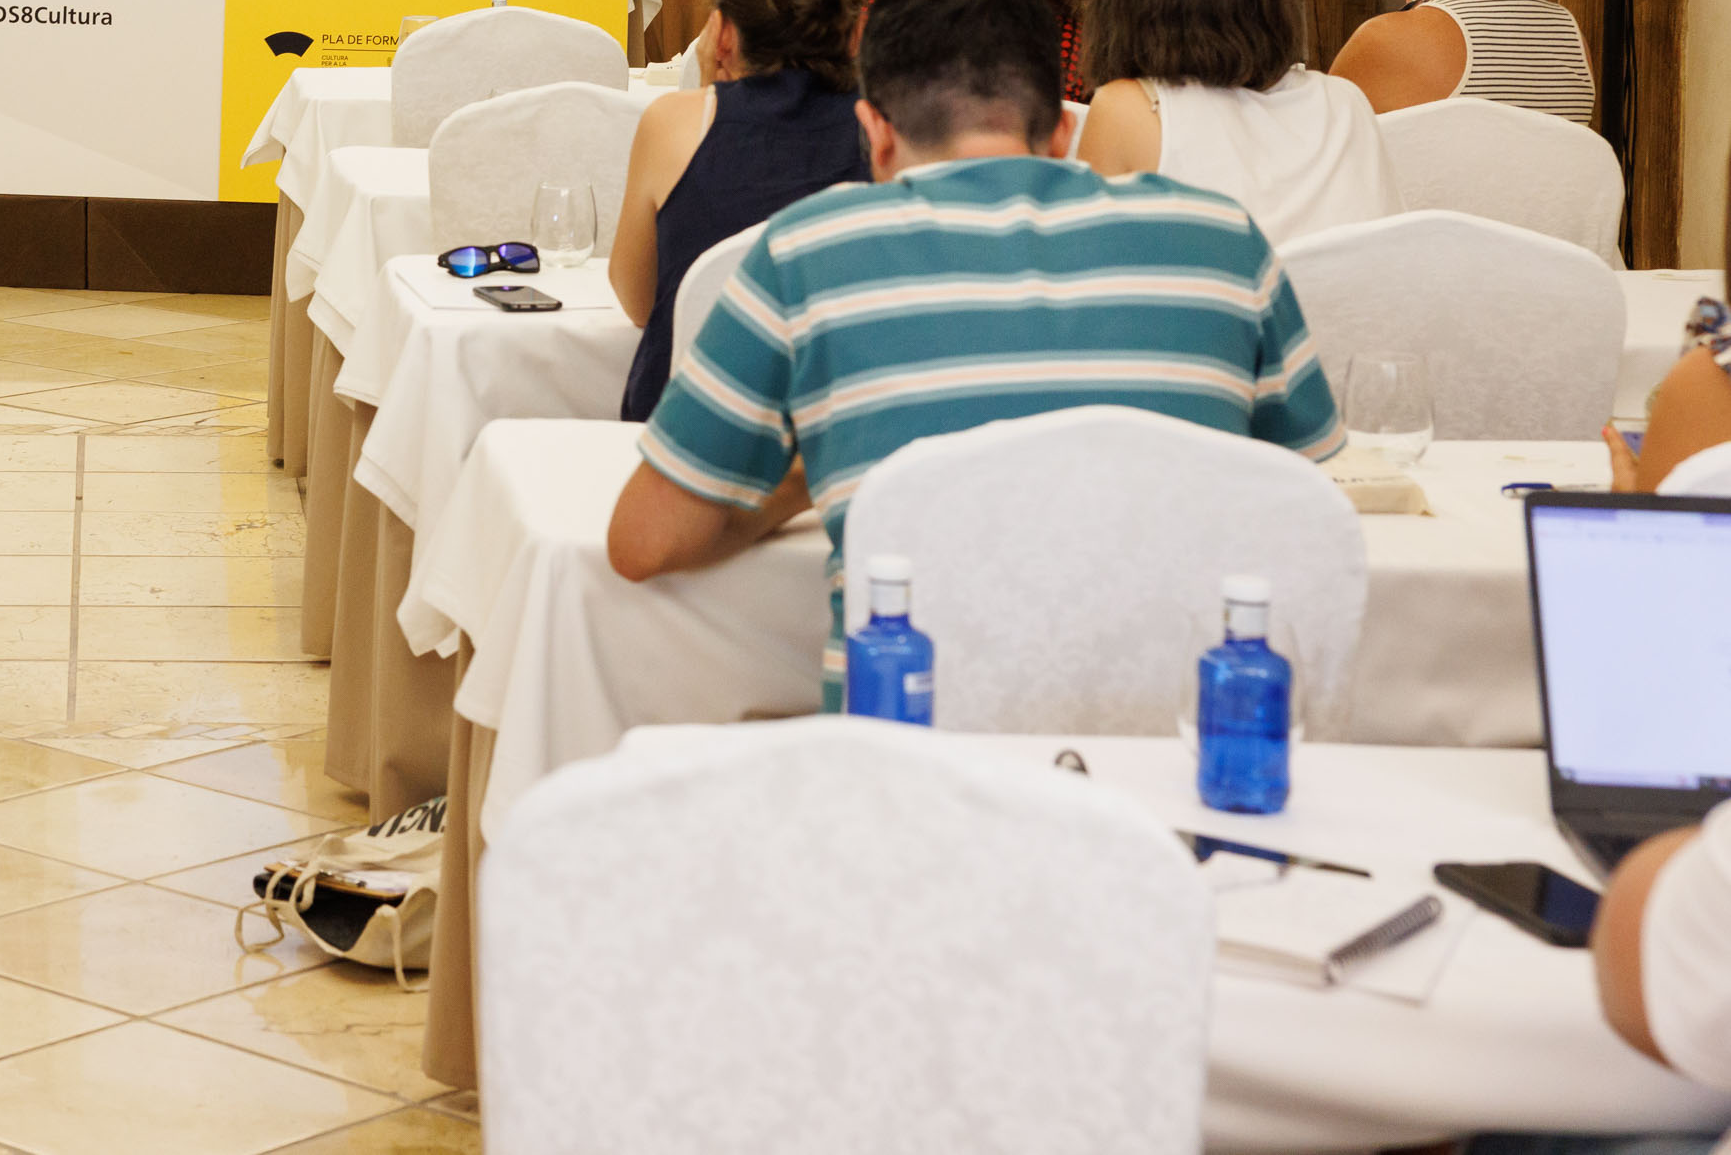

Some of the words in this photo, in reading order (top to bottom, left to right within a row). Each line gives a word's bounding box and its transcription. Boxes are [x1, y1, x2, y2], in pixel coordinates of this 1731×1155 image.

[322, 34, 344, 44] PLA
[347, 35, 363, 45] DE
[366, 35, 399, 46] FORM
